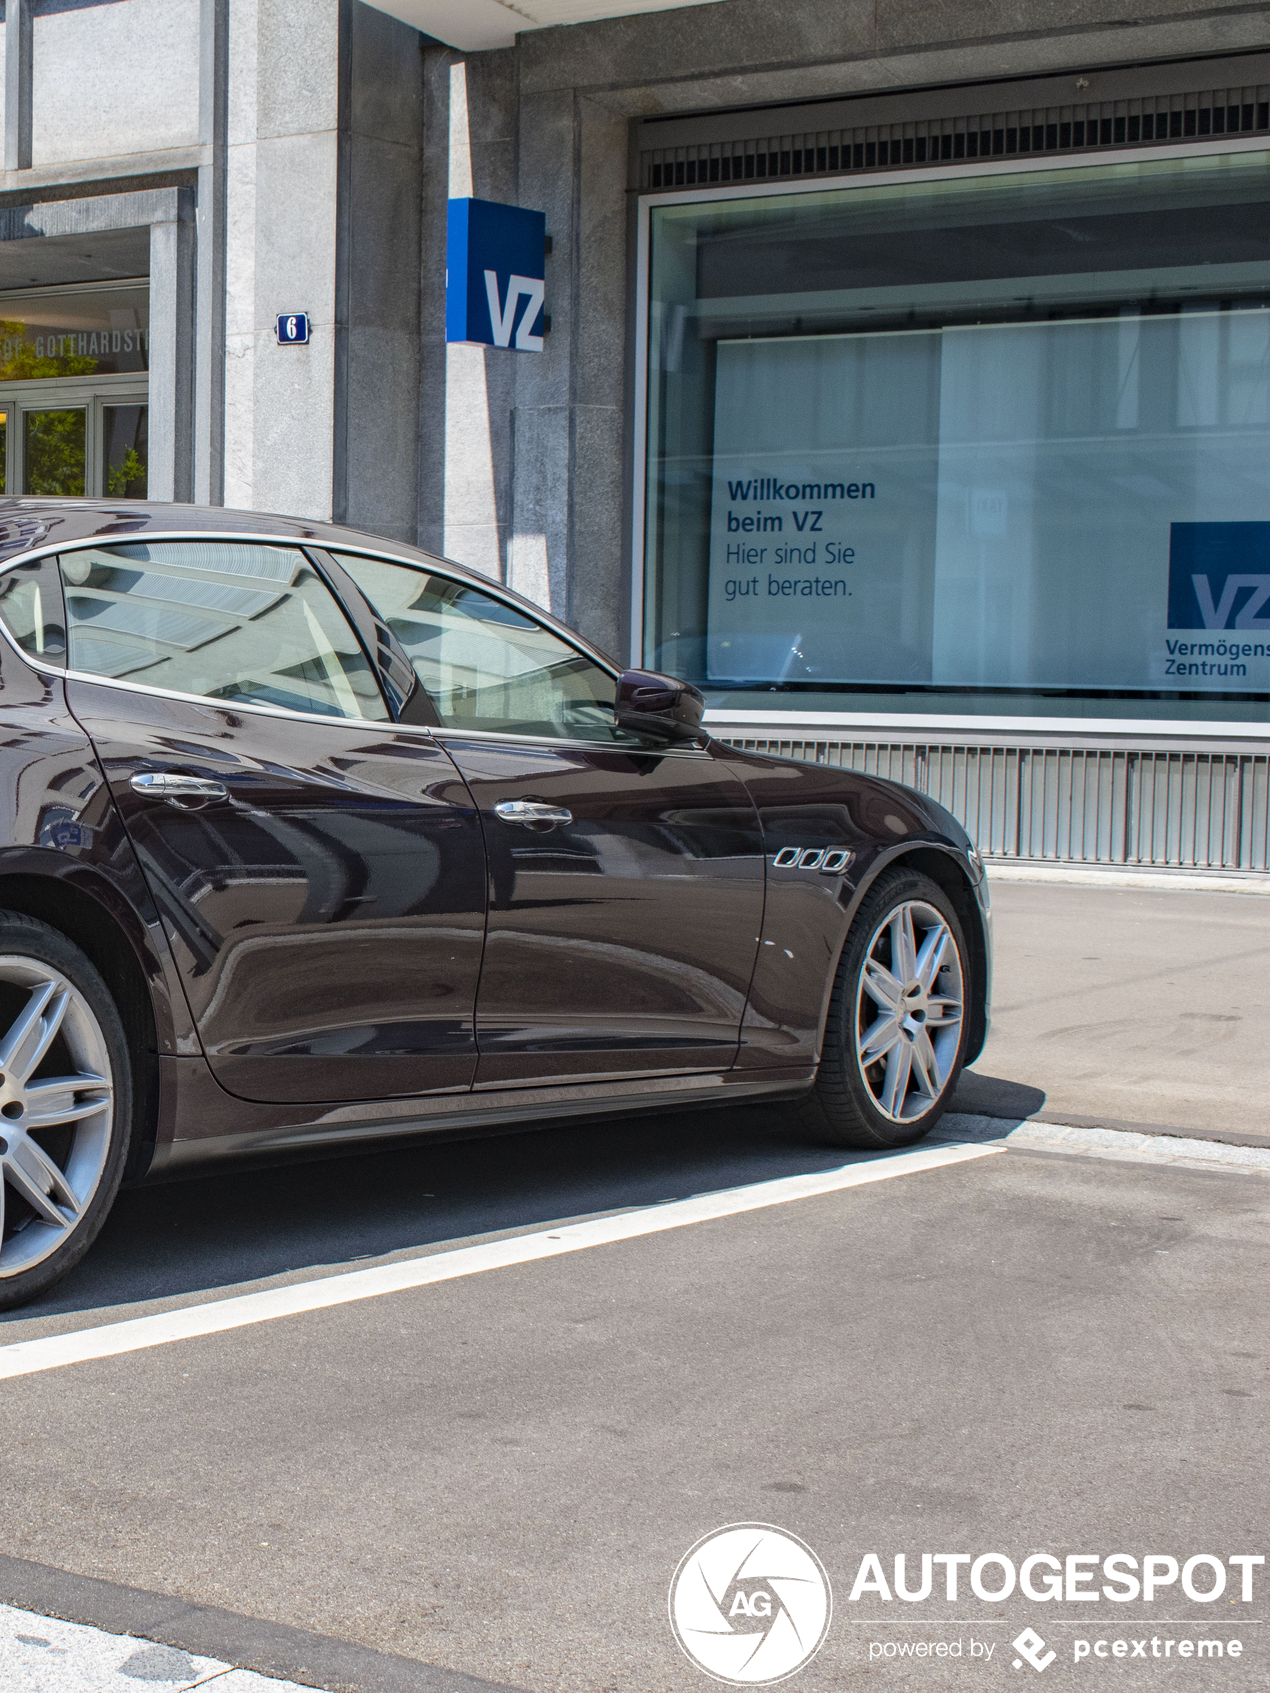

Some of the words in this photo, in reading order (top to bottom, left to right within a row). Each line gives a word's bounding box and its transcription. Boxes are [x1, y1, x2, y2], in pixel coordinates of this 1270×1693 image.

[484, 269, 545, 352] VZ
[286, 316, 297, 339] 6
[35, 328, 149, 359] GOTTHARDST
[728, 478, 875, 500] Willkommen
[727, 511, 783, 532] beim
[792, 511, 823, 532] VZ
[726, 543, 767, 564] Hier
[775, 542, 816, 564] sind
[825, 542, 855, 564] Sie
[725, 576, 759, 601] gut
[768, 574, 852, 596] beraten.
[1191, 574, 1270, 629] VZ
[1165, 659, 1247, 676] Zentrum
